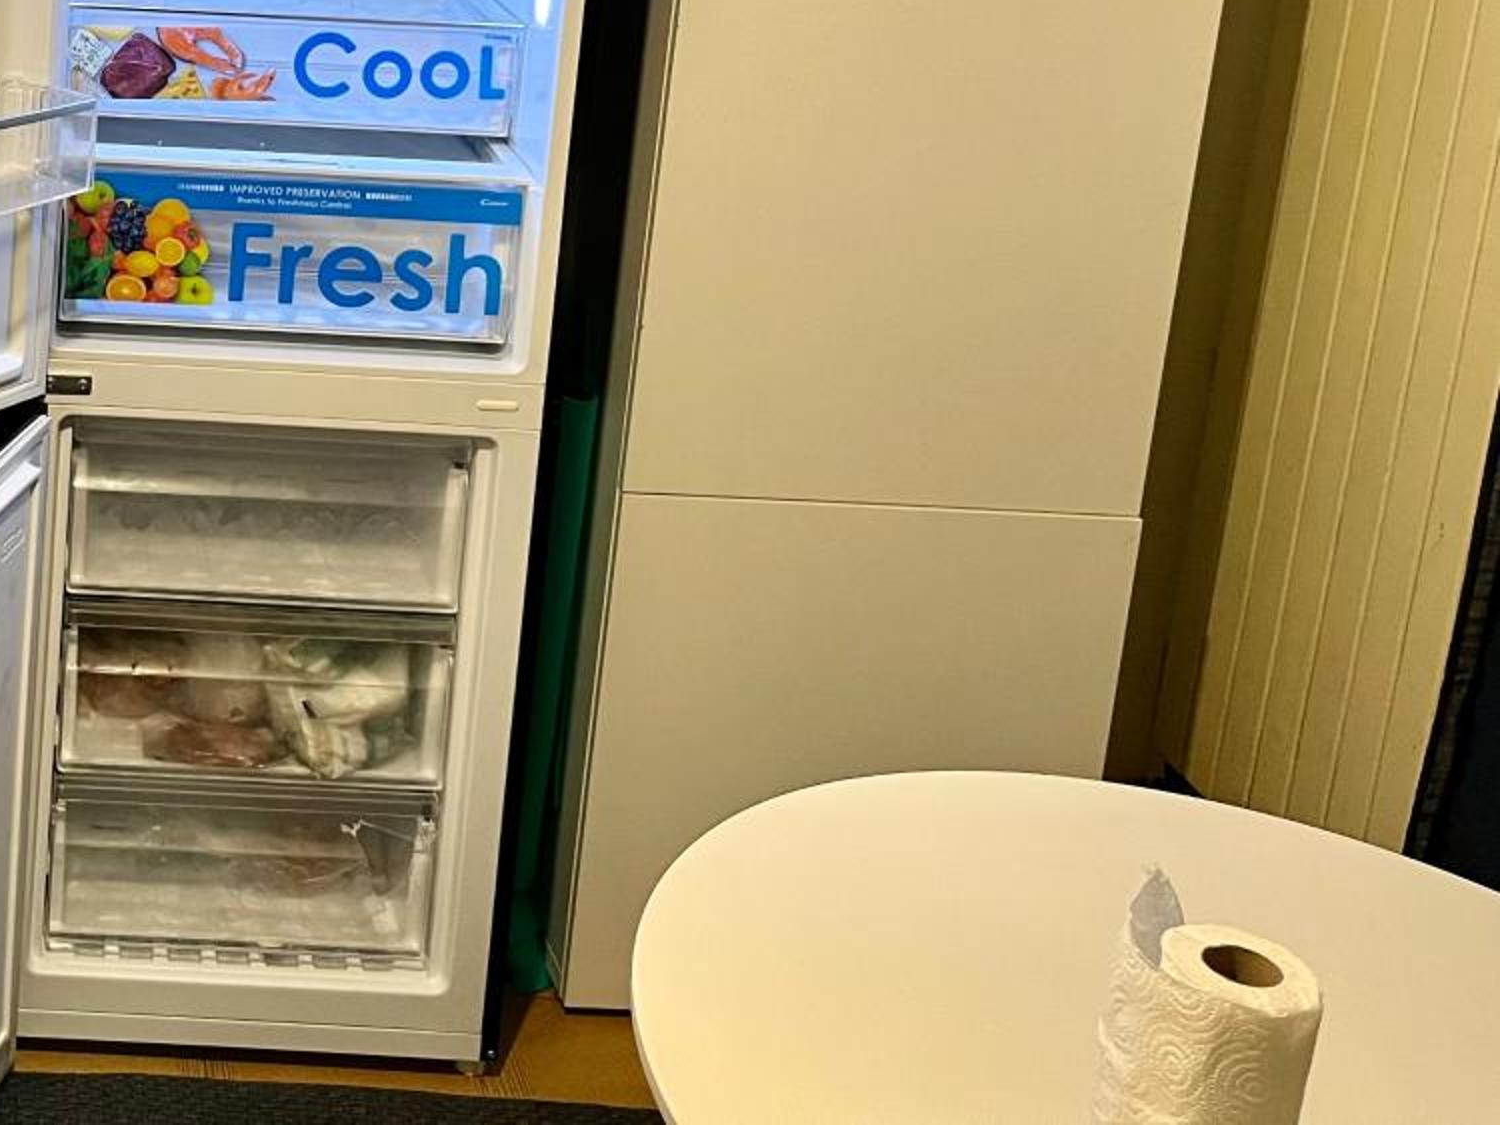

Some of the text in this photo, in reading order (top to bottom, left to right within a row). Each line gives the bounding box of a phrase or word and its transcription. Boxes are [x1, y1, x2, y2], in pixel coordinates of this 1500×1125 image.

[229, 184, 360, 199] IMPROVED PRESERVATION
[228, 221, 502, 315] Fresh
